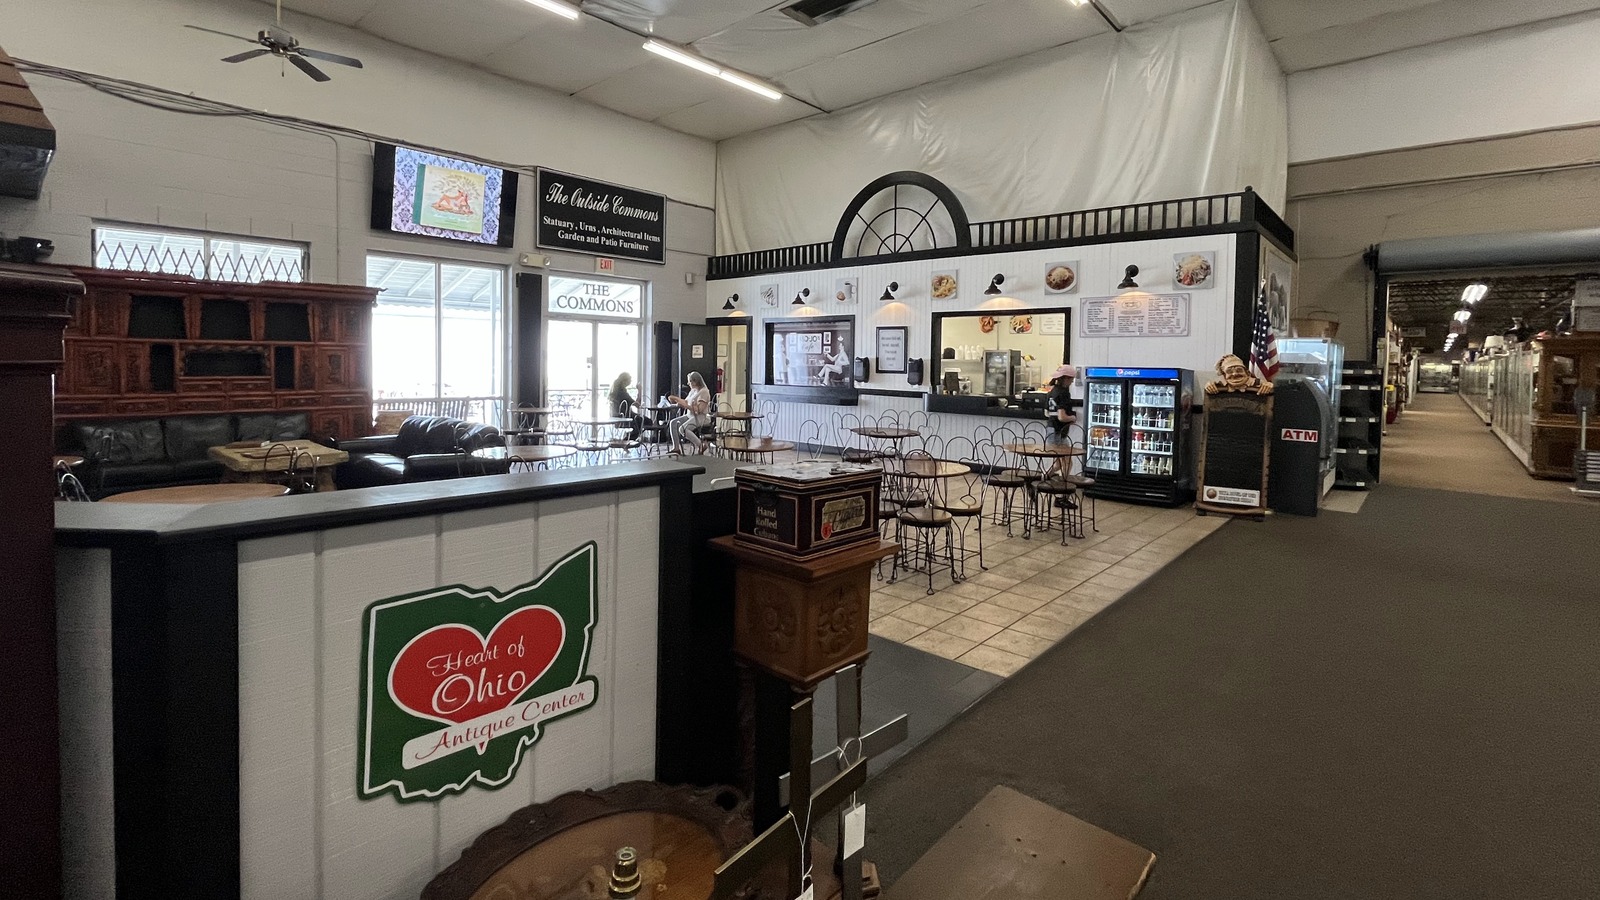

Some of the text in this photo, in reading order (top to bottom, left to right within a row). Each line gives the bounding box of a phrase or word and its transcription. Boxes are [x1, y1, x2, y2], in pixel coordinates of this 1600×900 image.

[546, 183, 659, 222] The Outside Commons
[558, 230, 650, 252] Garden and Patio Furniture
[601, 226, 643, 240] Architectural
[644, 232, 661, 242] Items
[600, 259, 613, 271] EXIT
[583, 283, 610, 296] THE
[557, 294, 634, 313] COMMONS
[1282, 429, 1318, 442] ATM
[757, 506, 777, 519] Hand
[755, 516, 778, 530] Rolled
[426, 635, 525, 677] Heart of
[431, 667, 527, 715] Ohio
[415, 690, 586, 760] Antique Center
